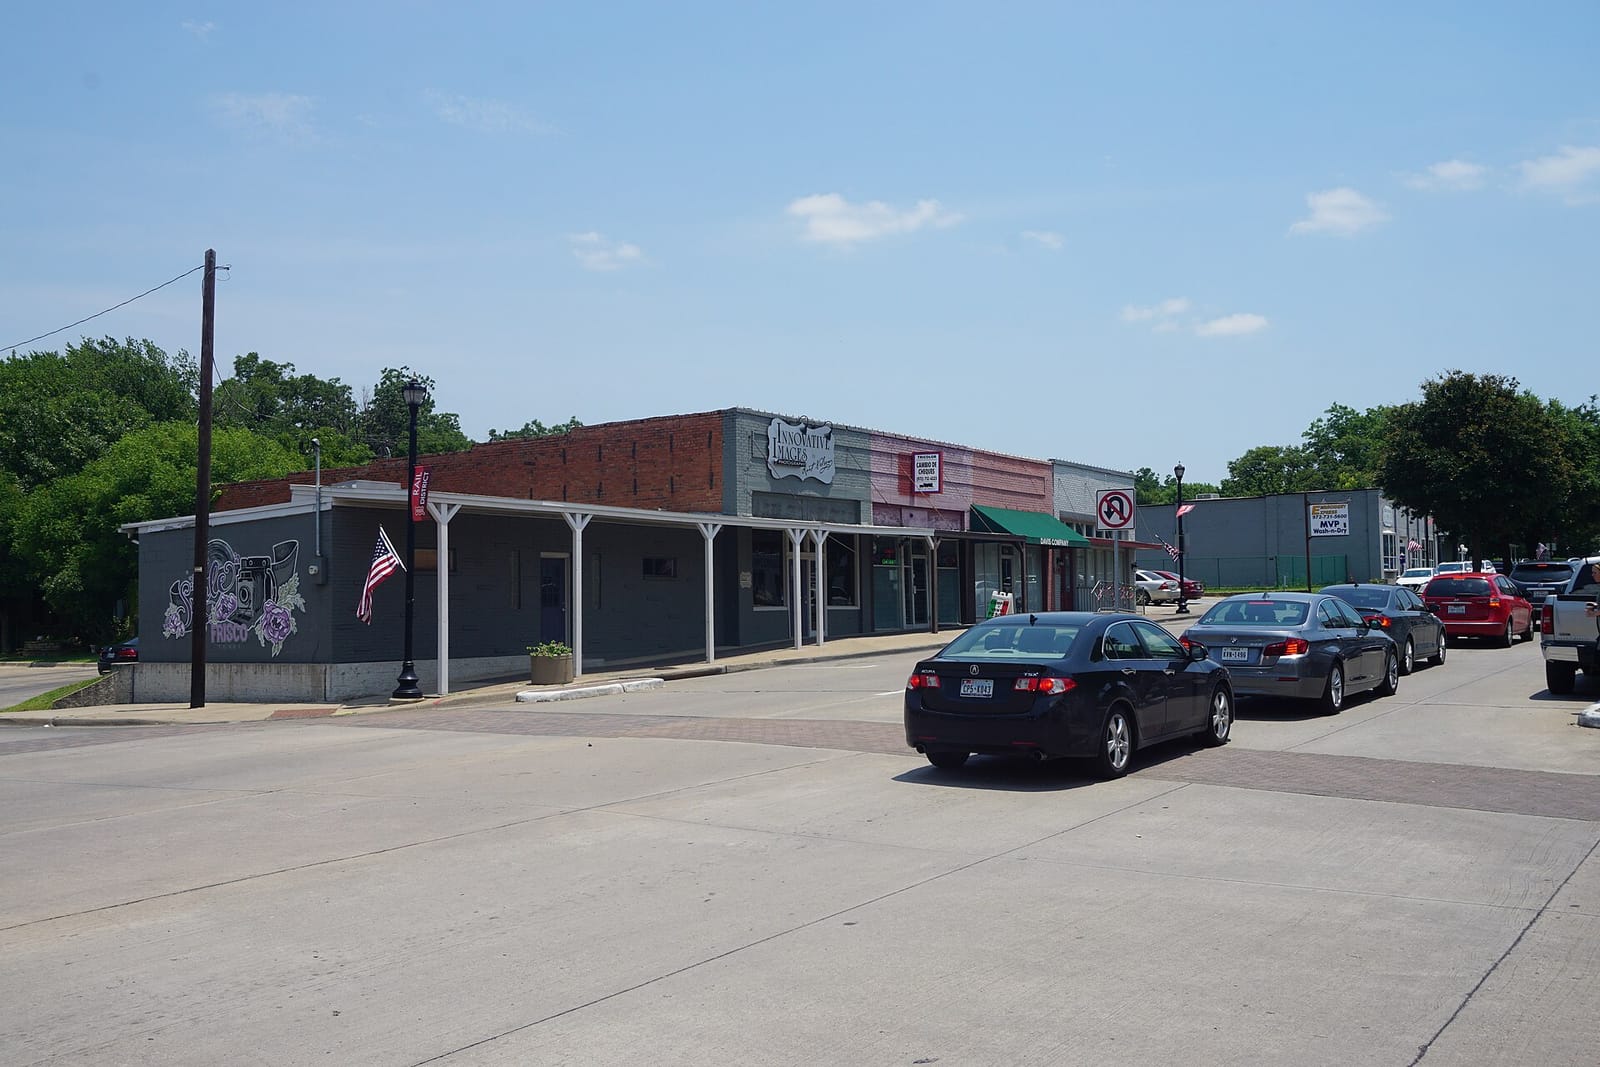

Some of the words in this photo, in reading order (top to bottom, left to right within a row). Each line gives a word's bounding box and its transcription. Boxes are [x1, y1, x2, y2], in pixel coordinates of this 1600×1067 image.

[777, 422, 830, 450] INNOVATIVE
[773, 437, 808, 461] IMAGES
[413, 472, 423, 496] RAIL
[420, 472, 429, 504] DISTRICT
[1320, 520, 1340, 528] MVP
[1051, 538, 1069, 547] COMPANY
[210, 622, 248, 643] FRISCO
